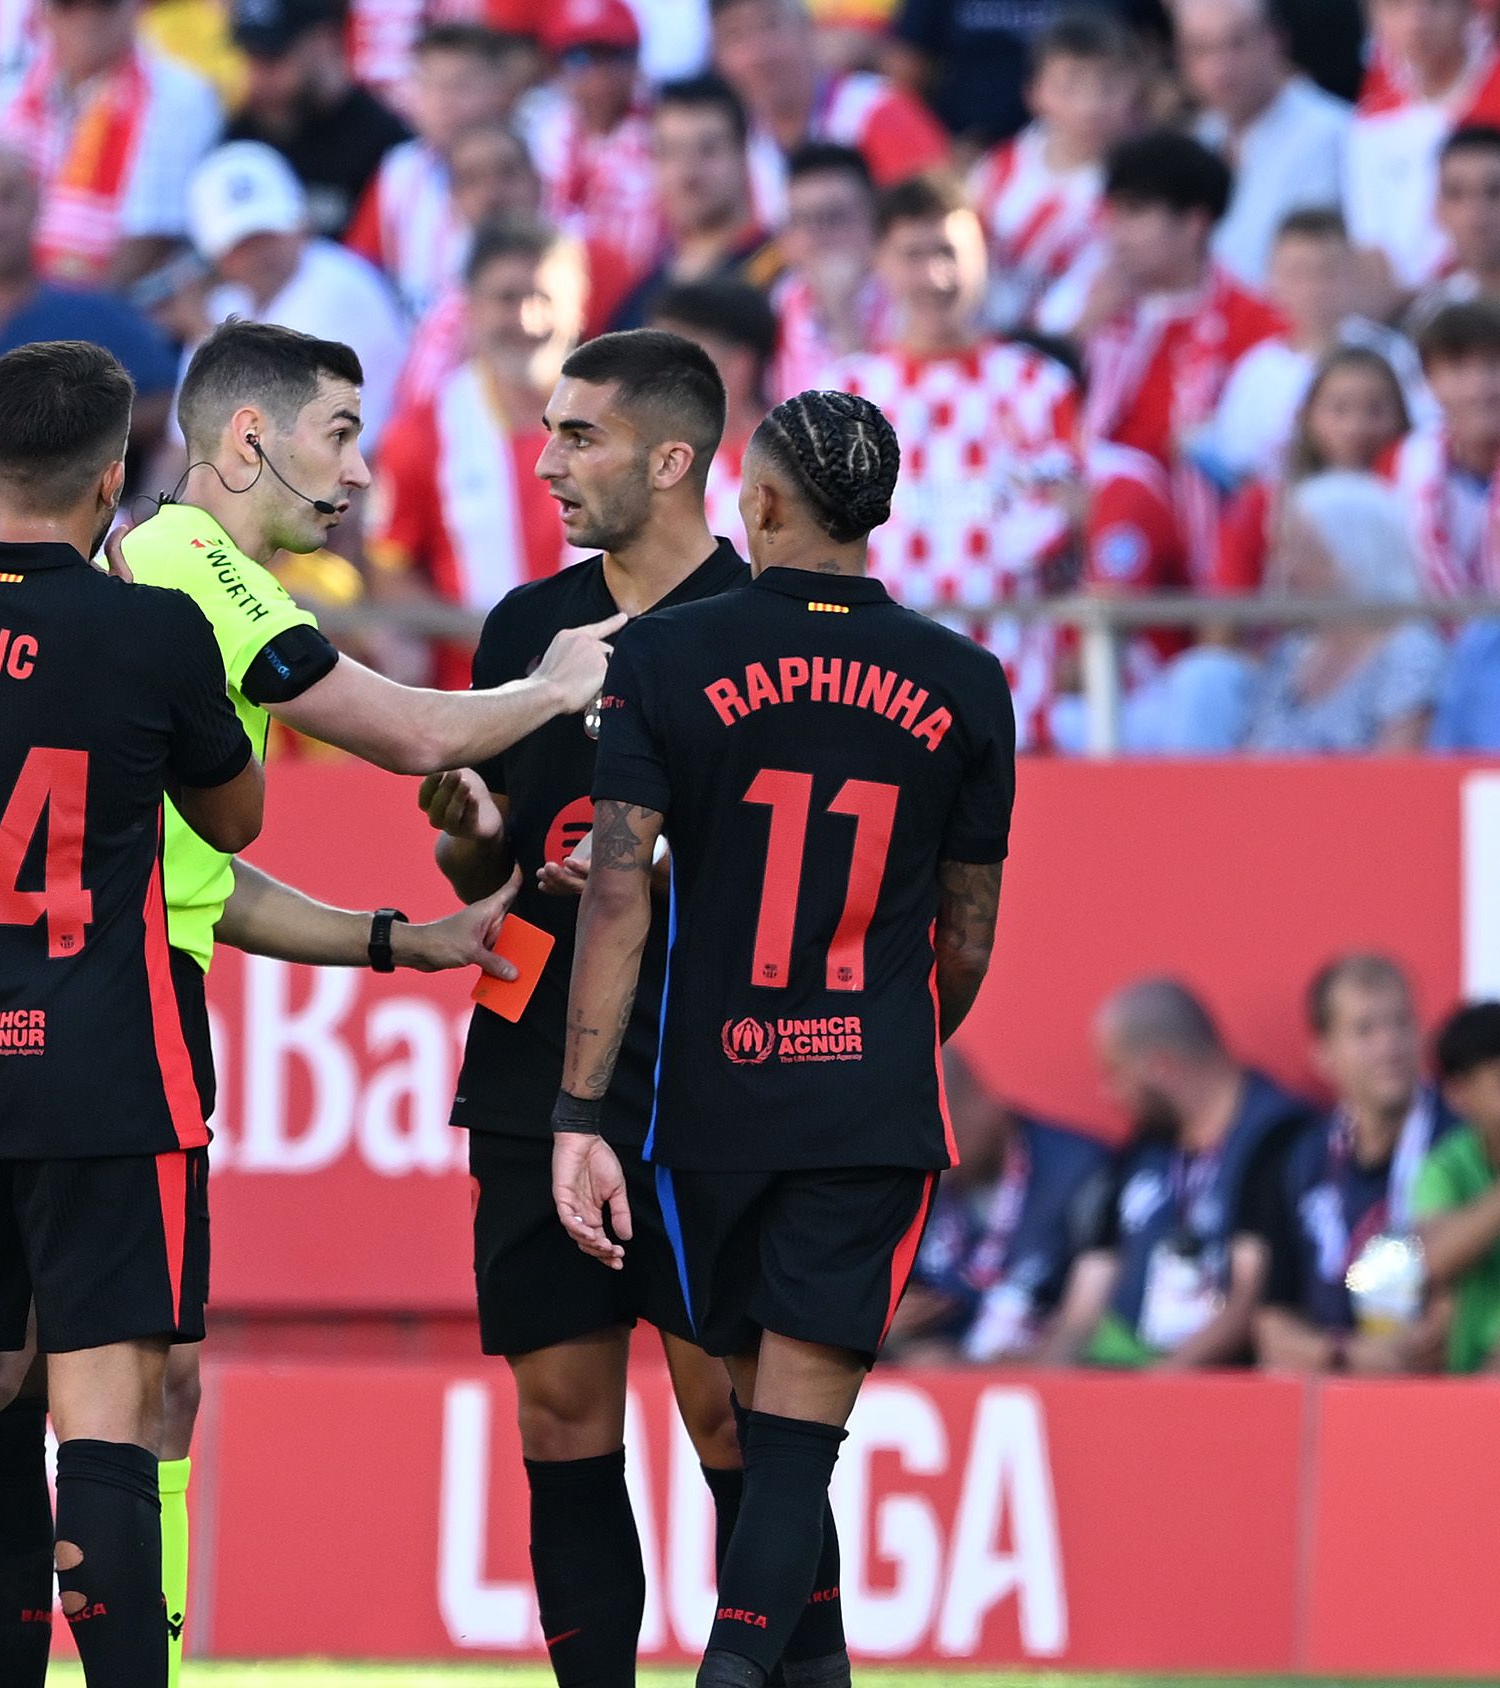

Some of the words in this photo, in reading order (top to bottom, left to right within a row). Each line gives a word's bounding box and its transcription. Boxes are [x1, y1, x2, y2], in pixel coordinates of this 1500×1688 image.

[206, 549, 269, 622] WÜRTH
[703, 657, 953, 752] RAPHINHA
[743, 768, 900, 991] 11
[777, 1016, 861, 1036] UNHCR
[778, 1035, 862, 1054] ACNUR
